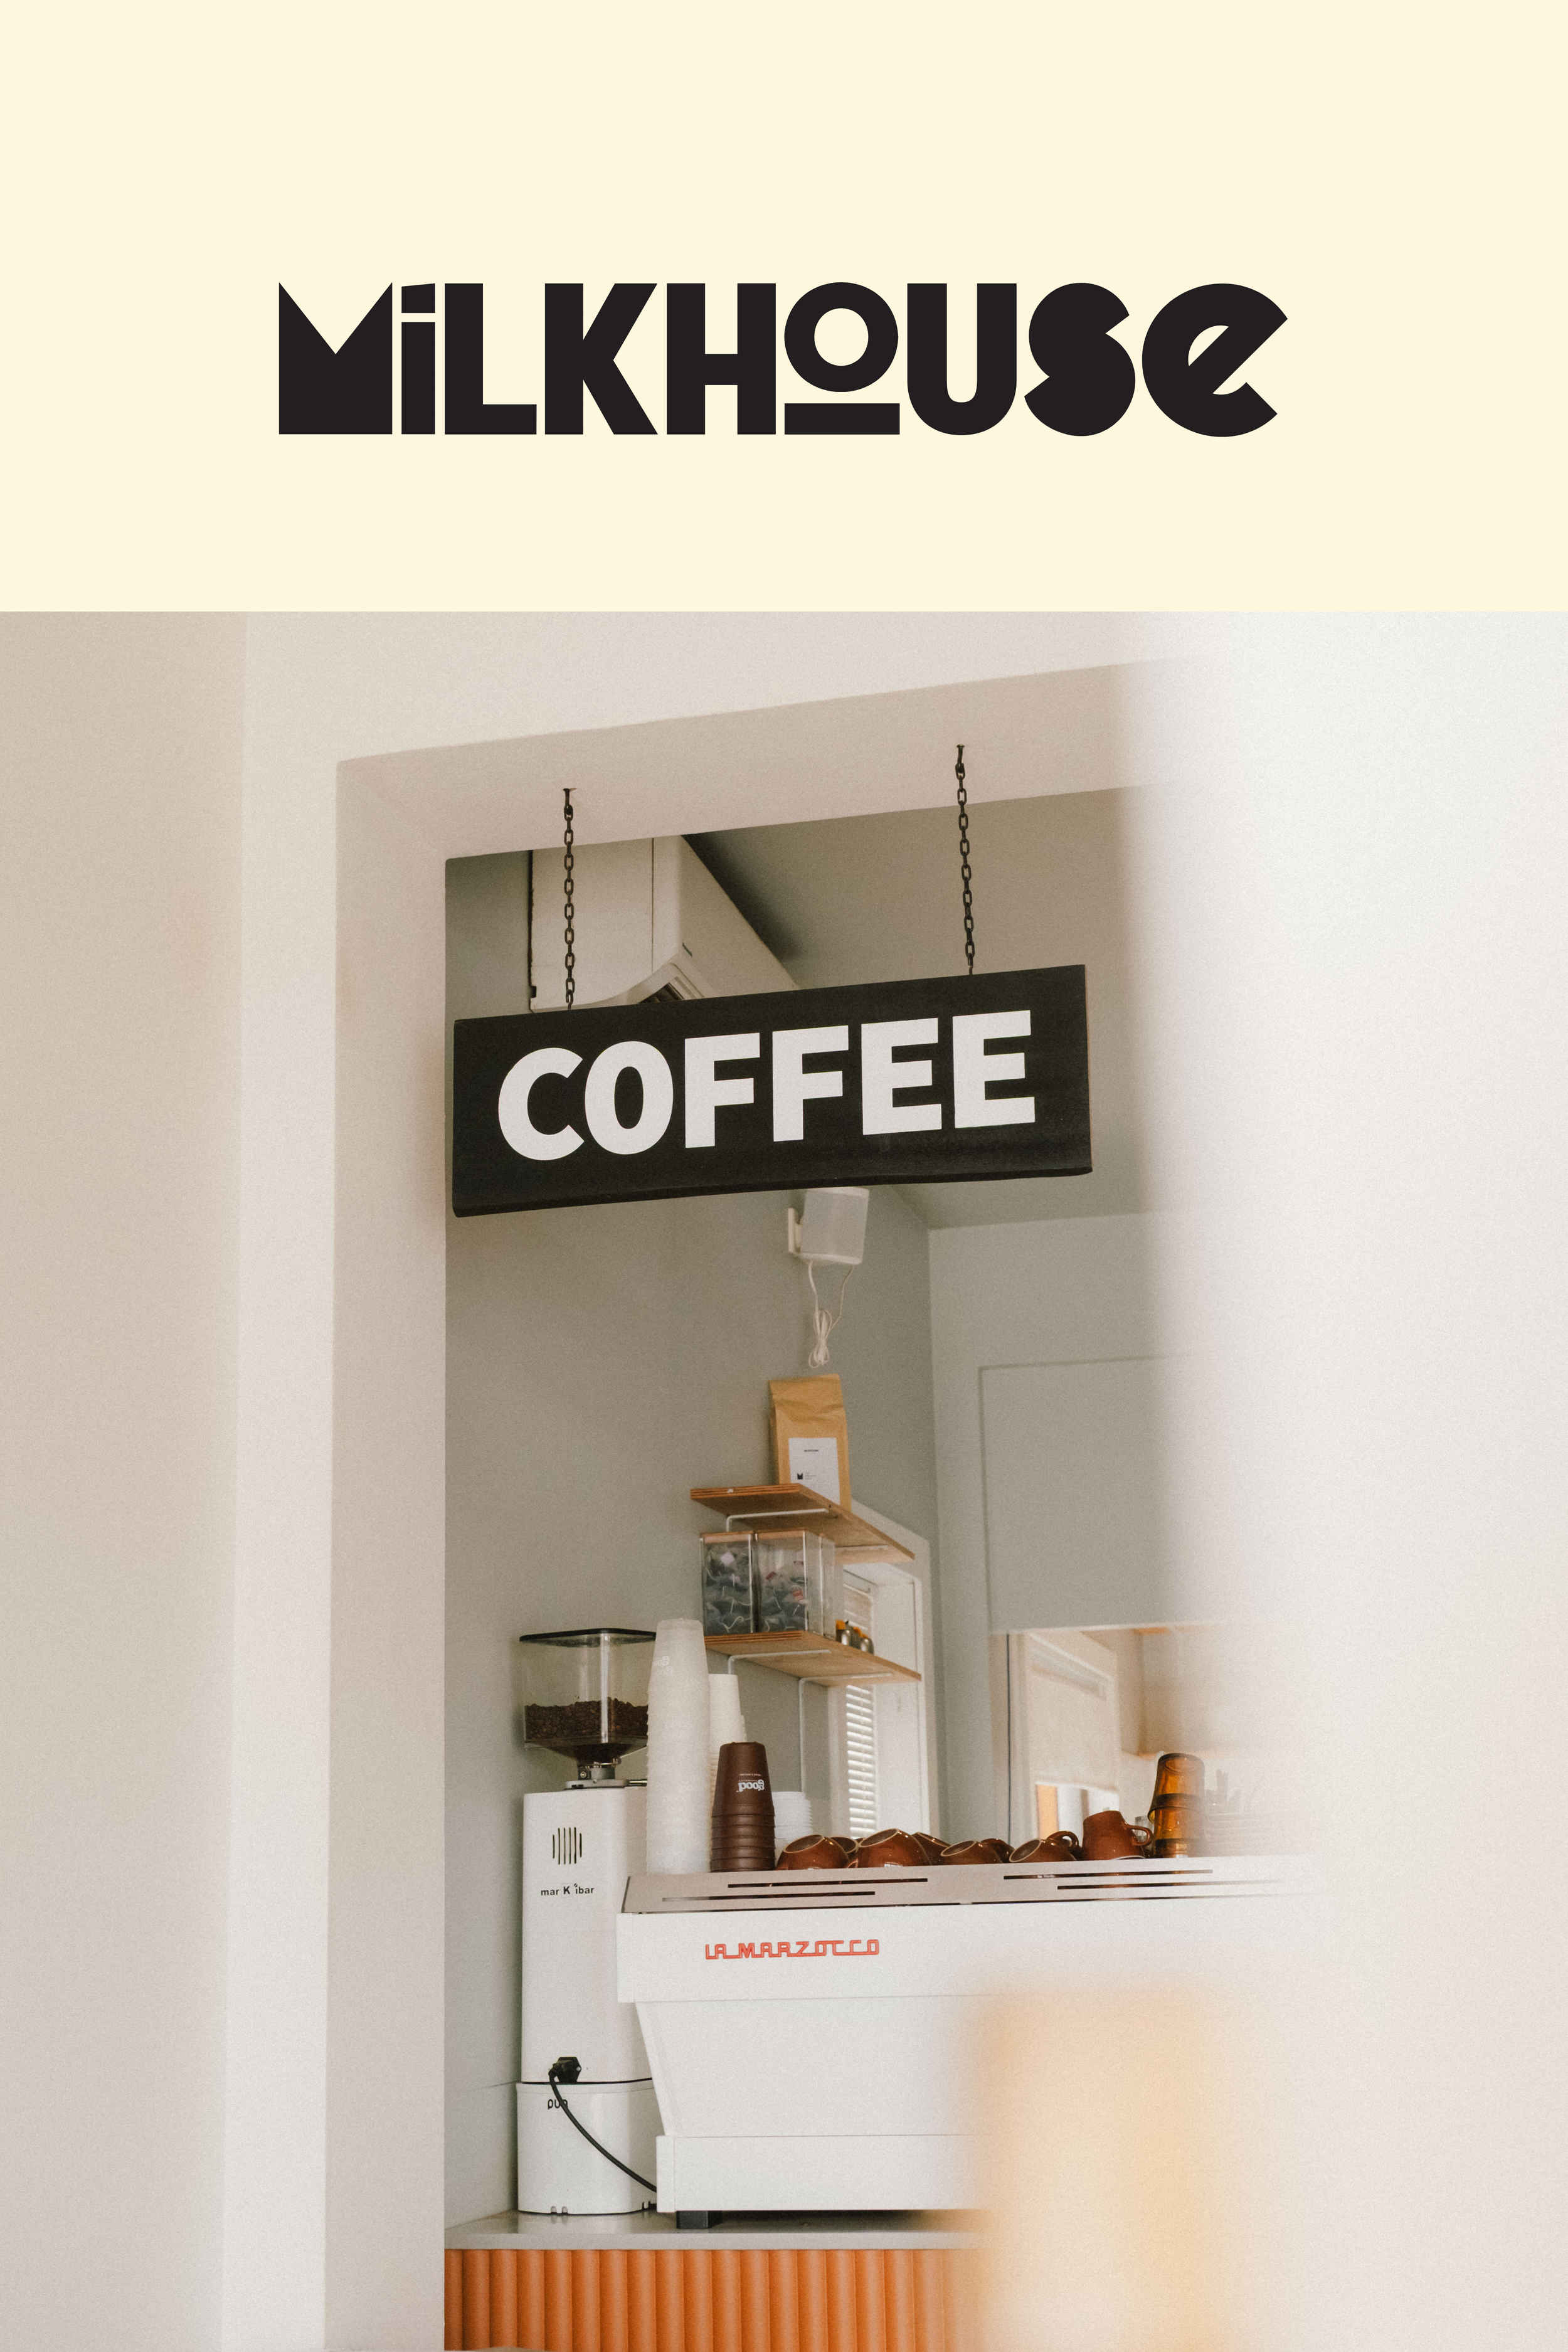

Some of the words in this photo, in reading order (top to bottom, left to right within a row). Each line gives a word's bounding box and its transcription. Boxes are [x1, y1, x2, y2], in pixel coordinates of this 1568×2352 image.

[498, 1010, 1036, 1160] COFFEE
[738, 1779, 765, 1793] good
[705, 1944, 727, 1960] LA
[738, 1939, 879, 1959] MARZOCCO
